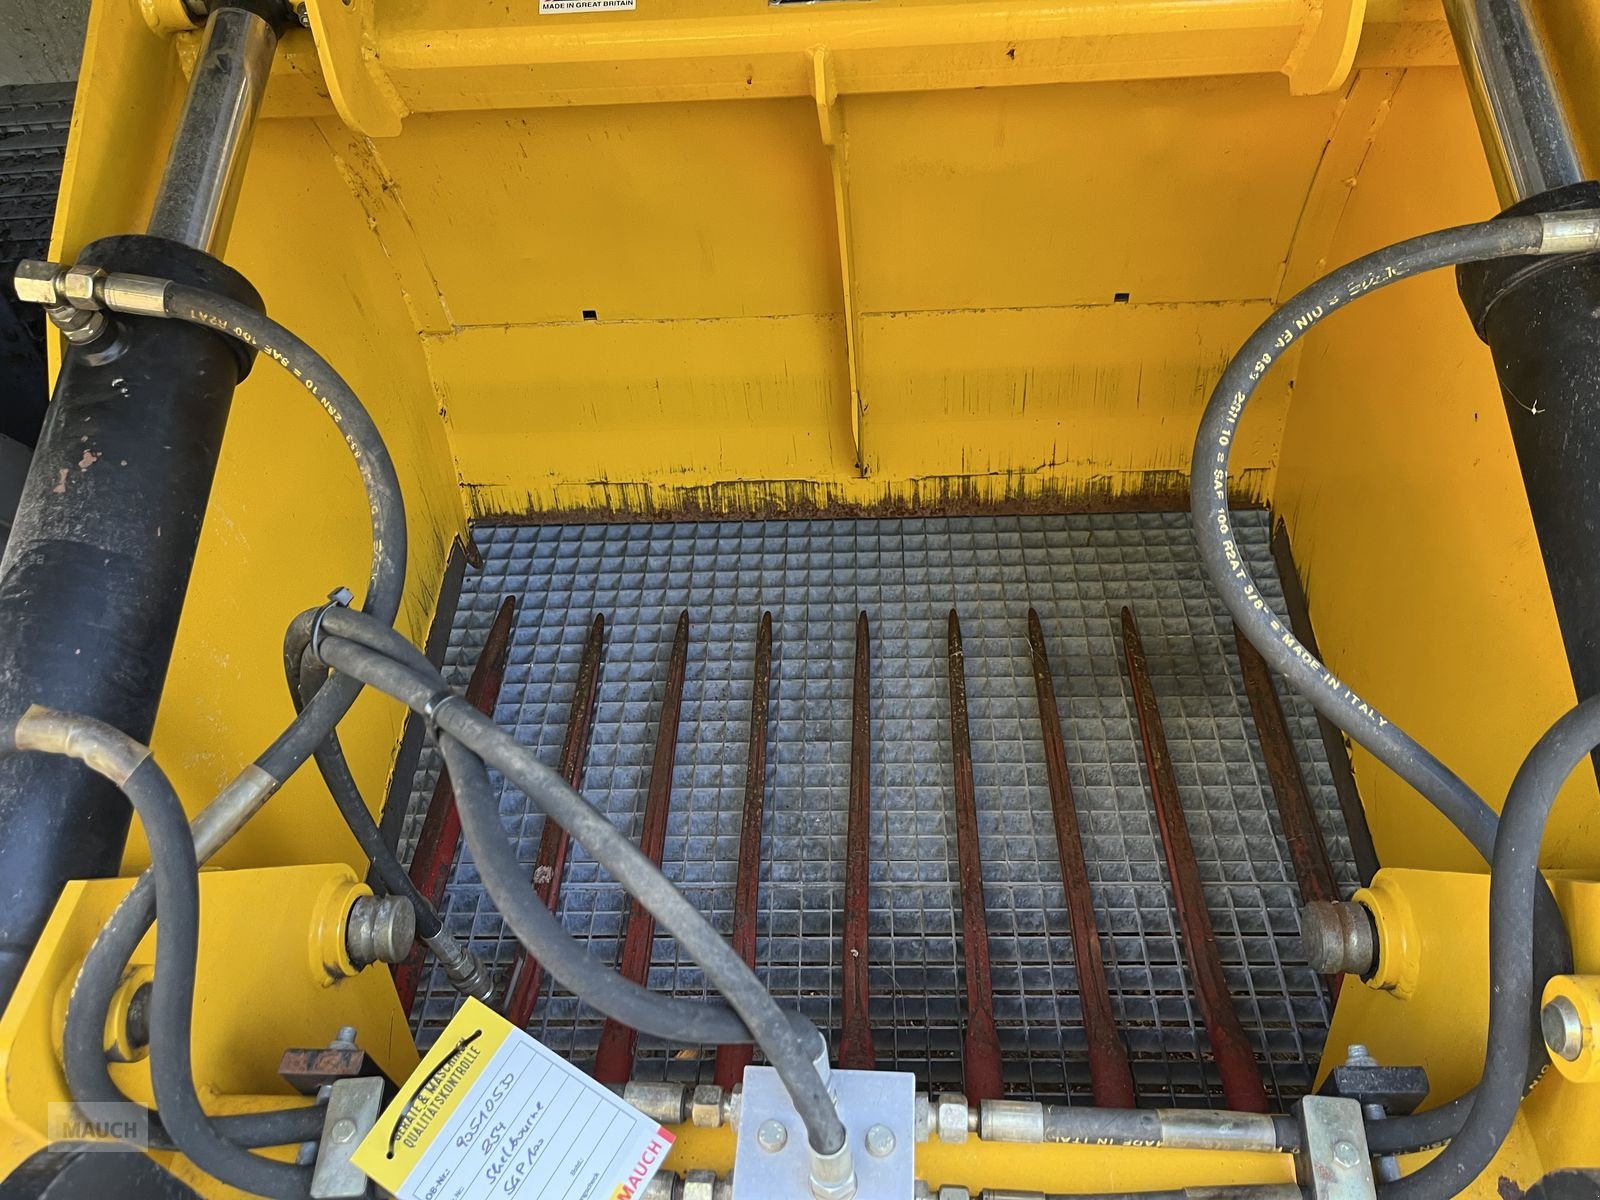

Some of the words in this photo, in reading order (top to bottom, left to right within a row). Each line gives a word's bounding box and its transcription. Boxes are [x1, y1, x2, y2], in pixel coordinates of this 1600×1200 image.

[233, 326, 257, 345] 100
[305, 379, 318, 395] 10
[1218, 429, 1231, 447] 10
[1216, 507, 1229, 535] 100
[1222, 539, 1247, 581] R2AT
[1281, 633, 1321, 671] MADE
[1323, 673, 1341, 690] IN
[1344, 690, 1389, 728] ITALY
[403, 1045, 481, 1148] QUALITÄTSKONTROLLE
